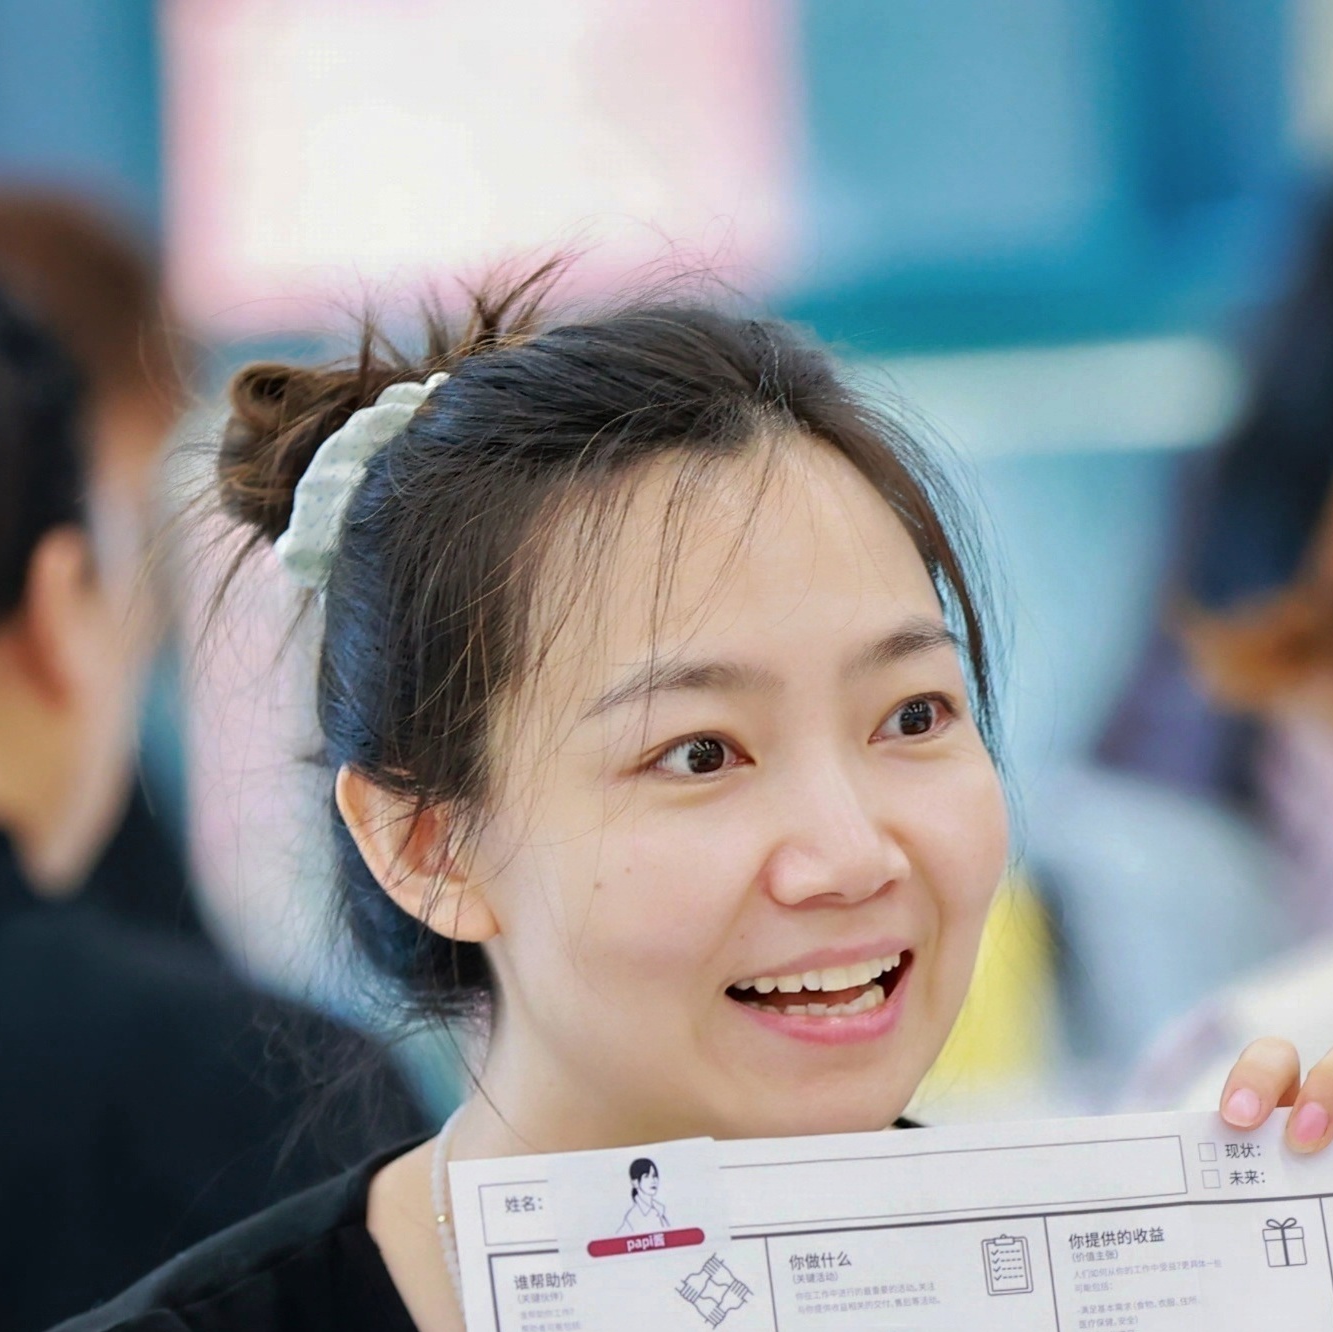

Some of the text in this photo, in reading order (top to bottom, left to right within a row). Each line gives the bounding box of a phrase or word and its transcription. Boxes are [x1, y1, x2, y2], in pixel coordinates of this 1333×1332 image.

[1225, 1142, 1261, 1159] 现状：
[1229, 1169, 1265, 1185] 未来：
[504, 1196, 544, 1214] 姓名：
[626, 1232, 666, 1253] papi酱
[1068, 1226, 1165, 1250] 你提供的收益
[789, 1250, 852, 1271] 你做什么
[1071, 1249, 1119, 1263] （价值主张）
[513, 1271, 577, 1290] 谁帮助你
[792, 1271, 838, 1285] （关键活动）
